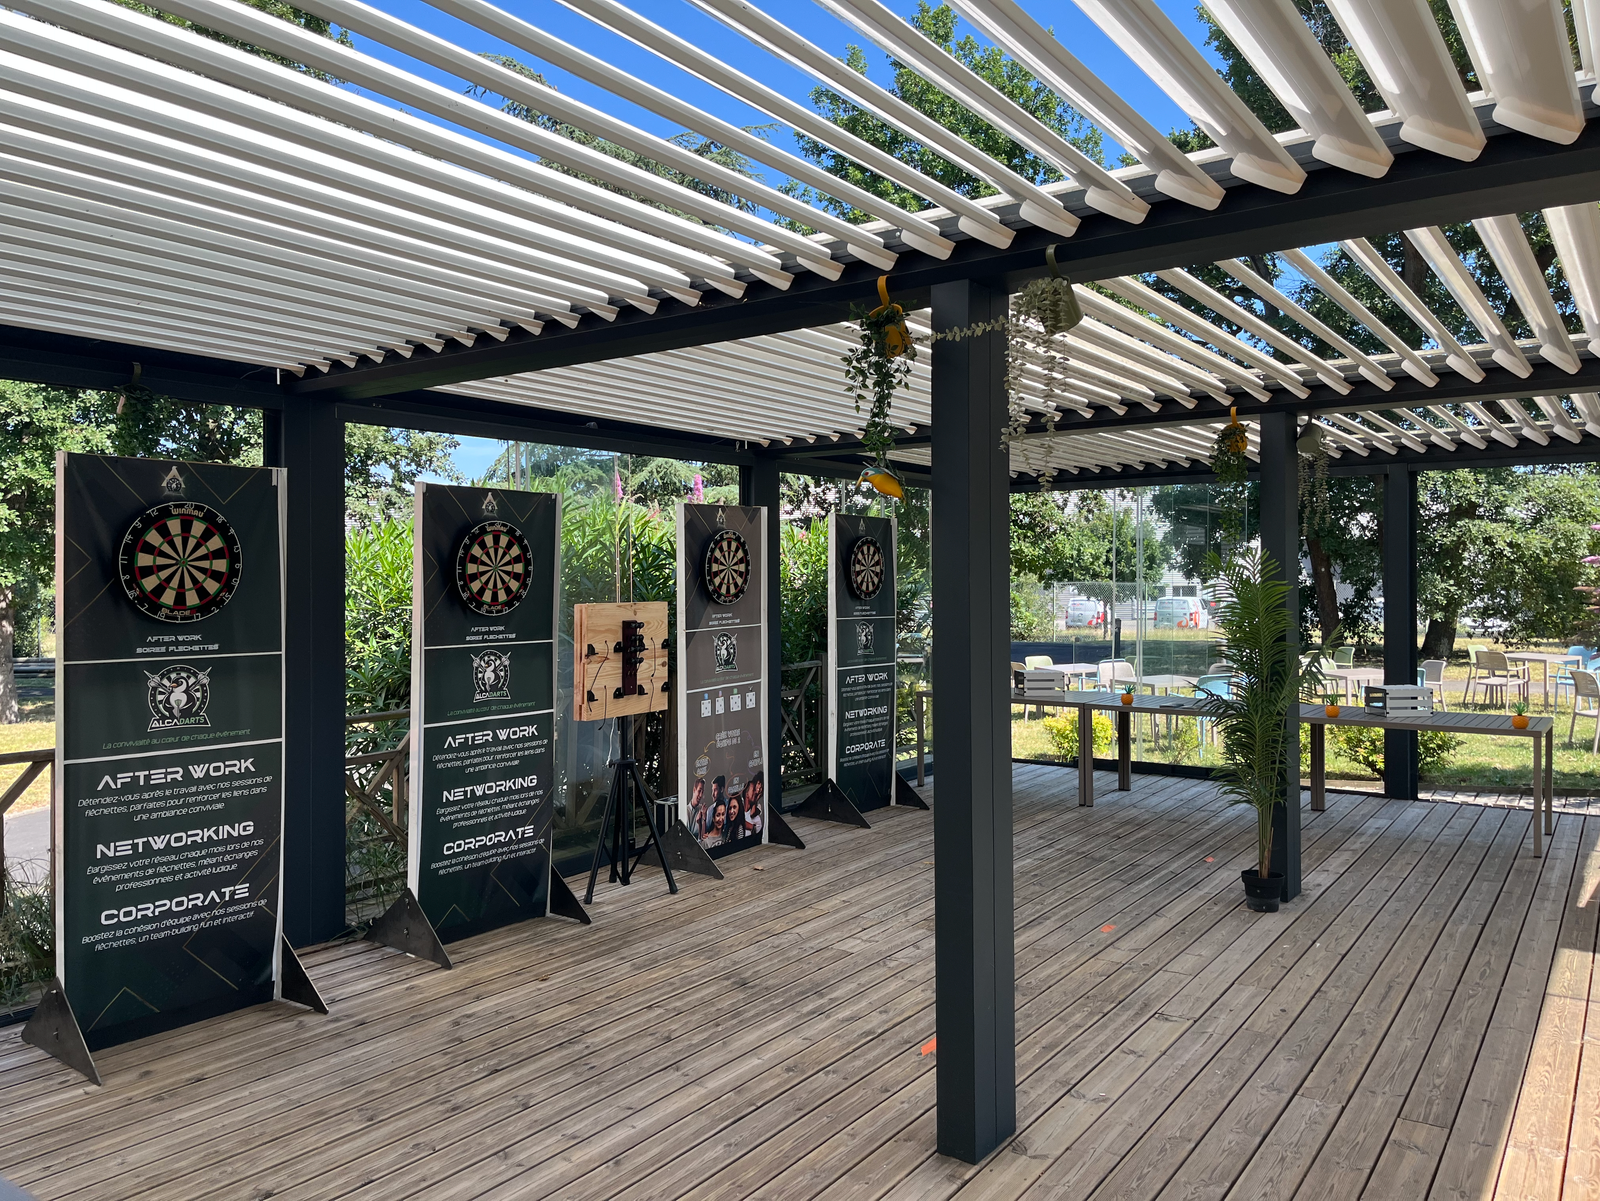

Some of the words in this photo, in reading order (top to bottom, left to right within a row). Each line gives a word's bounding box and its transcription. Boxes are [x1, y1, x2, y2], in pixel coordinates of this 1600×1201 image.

[172, 508, 204, 518] WINMAU
[846, 674, 865, 684] AFTER
[867, 672, 888, 681] WORK
[152, 716, 205, 728] ALCADARTS
[845, 706, 887, 719] NETWORKING
[444, 731, 493, 748] AFTER
[496, 725, 538, 740] WORK
[846, 739, 886, 754] CORPORATE
[96, 767, 183, 791] AFTER
[188, 758, 256, 779] WORK
[78, 793, 140, 807] Détendez-vous
[141, 790, 164, 800] après
[173, 785, 197, 795] travail
[198, 783, 216, 792] avec
[232, 776, 262, 787] sessions
[130, 801, 165, 812] parfaites
[166, 798, 185, 807] pour
[185, 793, 221, 803] renforcer
[233, 789, 249, 797] liens
[250, 786, 267, 795] dans
[442, 775, 538, 802] NETWORKING
[150, 807, 188, 819] ambiance
[96, 821, 254, 859] NETWORKING
[443, 825, 534, 855] CORPORATE
[86, 862, 128, 875] Élargissez
[129, 858, 150, 868] votre
[151, 853, 179, 864] réseau
[180, 849, 208, 860] chaque
[208, 845, 225, 853] mois
[145, 867, 155, 875] de
[198, 857, 223, 866] mêlant
[224, 849, 259, 861] échanges
[115, 875, 174, 892] professionnels
[184, 868, 211, 879] activité
[100, 883, 250, 926] CORPORATE
[82, 931, 115, 944] Boostez
[124, 922, 159, 935] cohésion
[192, 911, 211, 920] avec
[211, 908, 226, 916] nos
[226, 901, 258, 913] sessions
[138, 934, 149, 943] un
[150, 923, 199, 940] team-building
[199, 920, 213, 928] fun
